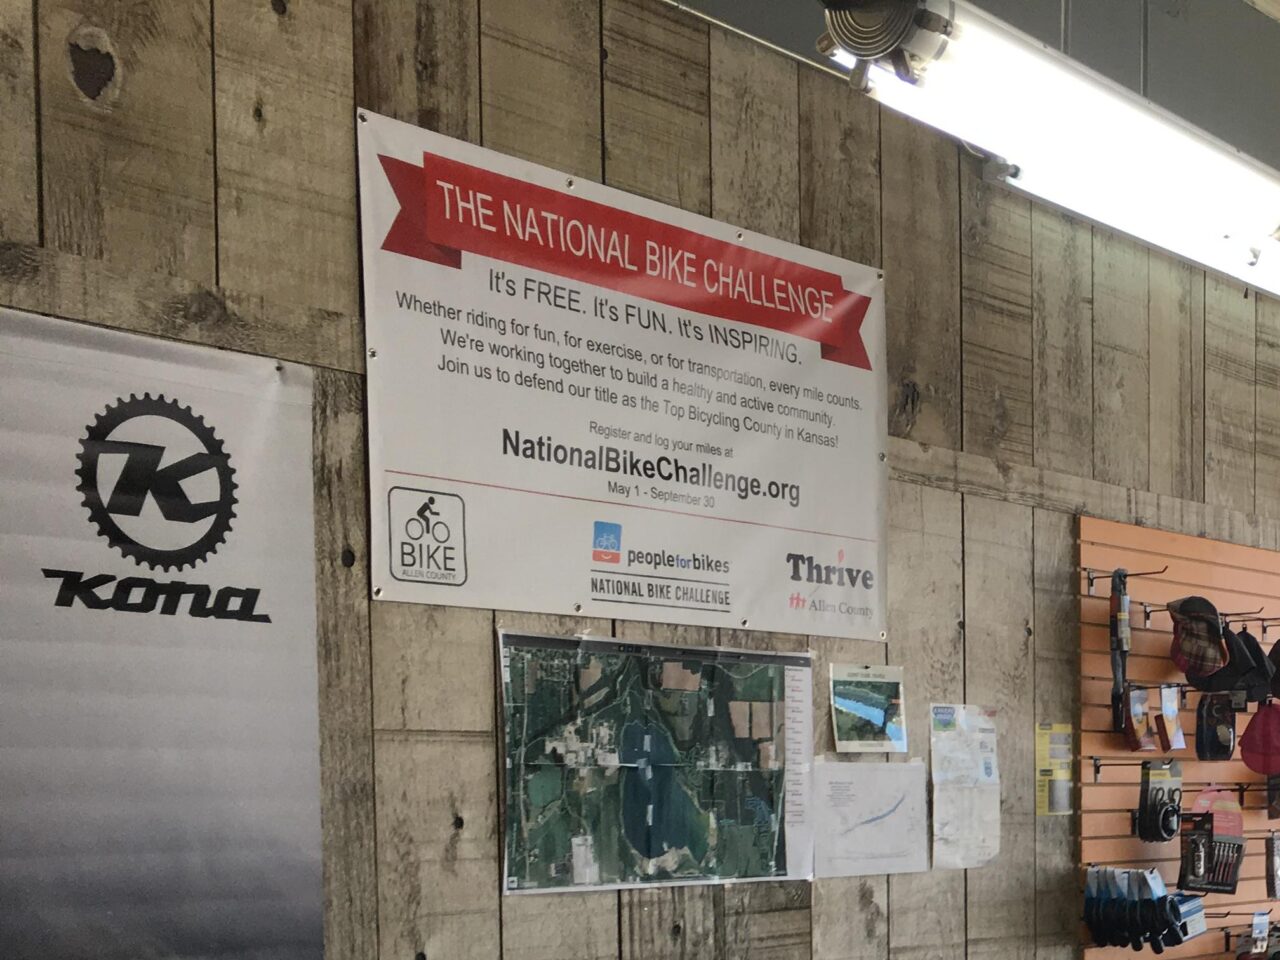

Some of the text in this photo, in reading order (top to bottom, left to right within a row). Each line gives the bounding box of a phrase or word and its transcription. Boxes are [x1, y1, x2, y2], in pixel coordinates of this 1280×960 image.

[436, 180, 834, 323] THE NATIONAL BIKE CHALLENGE
[489, 268, 802, 365] It's FREE. It's FUN. It's INSPIRING.
[396, 290, 863, 411] Whether riding for fun, for exercise, or for transportation, every mile counts.
[440, 328, 836, 429] We're working together to build a healthy and active community.
[437, 354, 839, 448] Join us to defend our title as the Top Bicycling County in Kansas!
[589, 421, 733, 458] Register and log your miles at
[502, 428, 801, 507] NationalBikeChallenge.org
[608, 481, 630, 498] May
[634, 485, 640, 497] 1
[650, 487, 701, 507] September
[703, 495, 715, 508] 30
[401, 542, 456, 572] BIKE
[402, 569, 456, 580] ALLEN COUNTY
[627, 549, 730, 573] peopleforbikes
[786, 549, 874, 590] Thrive
[591, 577, 730, 605] NATIONAL BIKE CHALLENGE
[808, 600, 873, 620] Allen County
